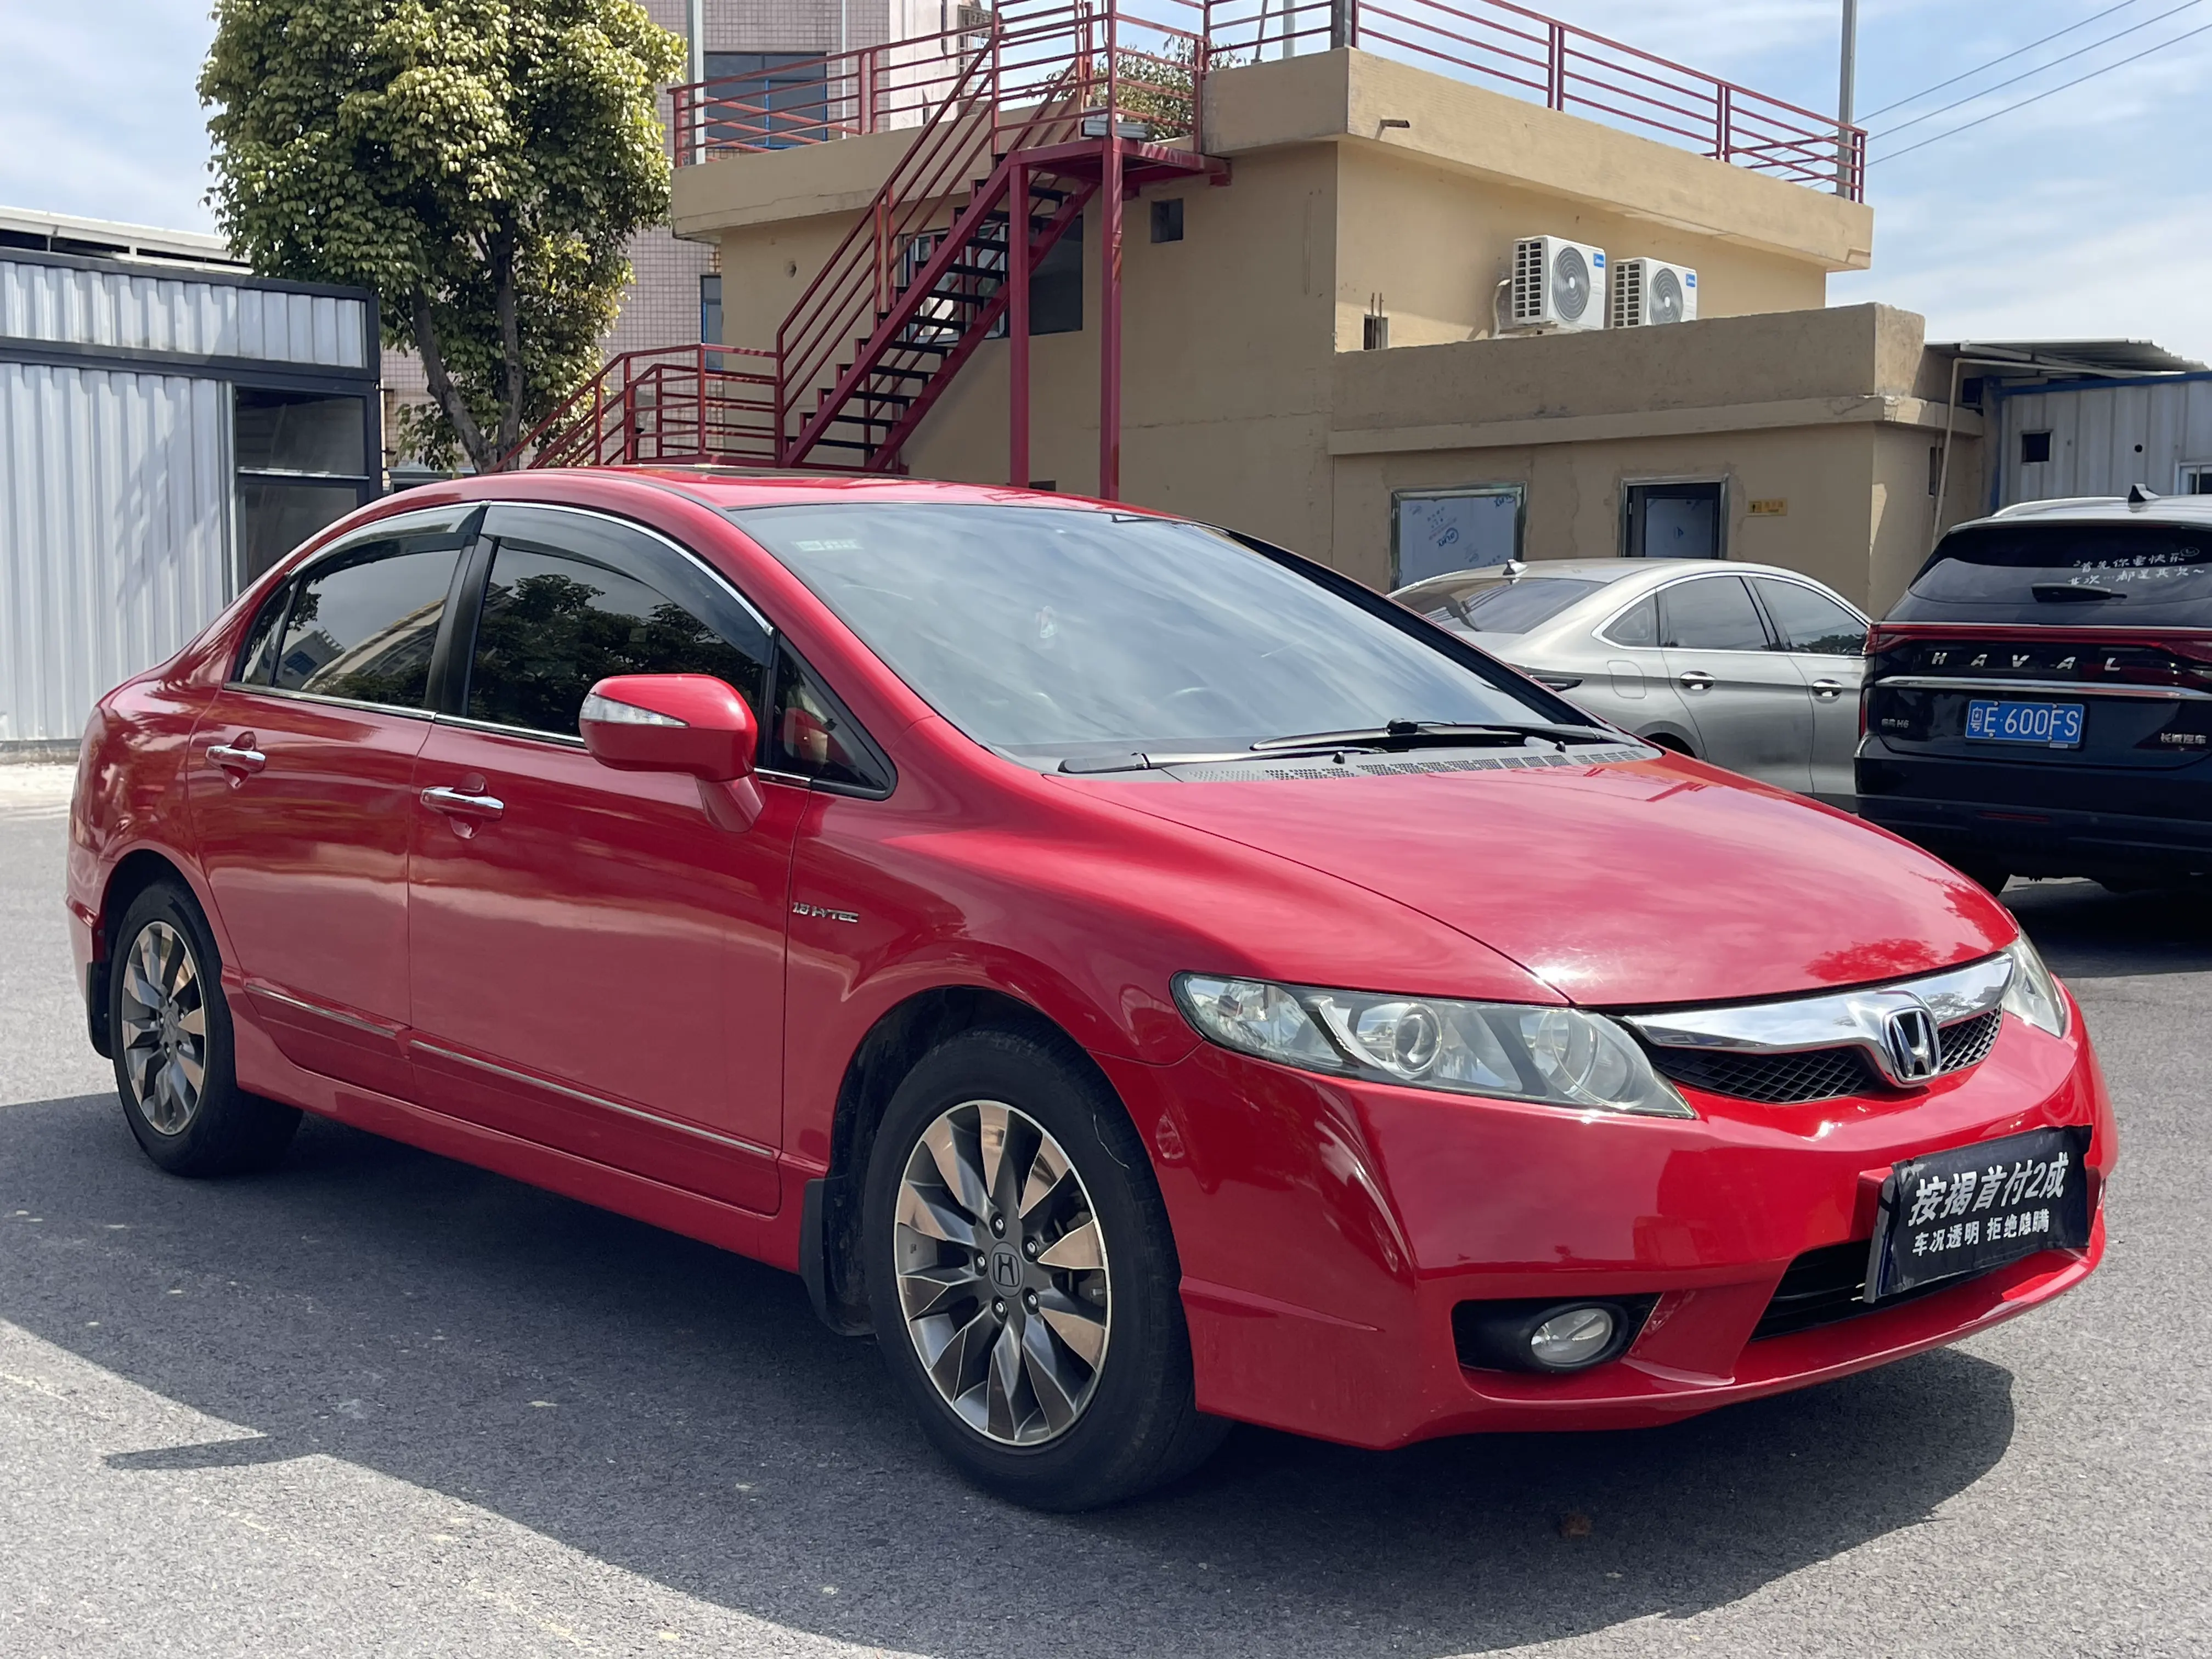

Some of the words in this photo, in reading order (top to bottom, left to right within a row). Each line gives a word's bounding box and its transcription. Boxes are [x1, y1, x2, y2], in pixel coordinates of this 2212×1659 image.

[1931, 652, 2121, 671] HAVAL
[1908, 1152, 2069, 1227] 按揭首付2成
[1912, 1221, 1980, 1256] 车况透明
[1987, 1209, 2050, 1242] 拒绝隐瞒
